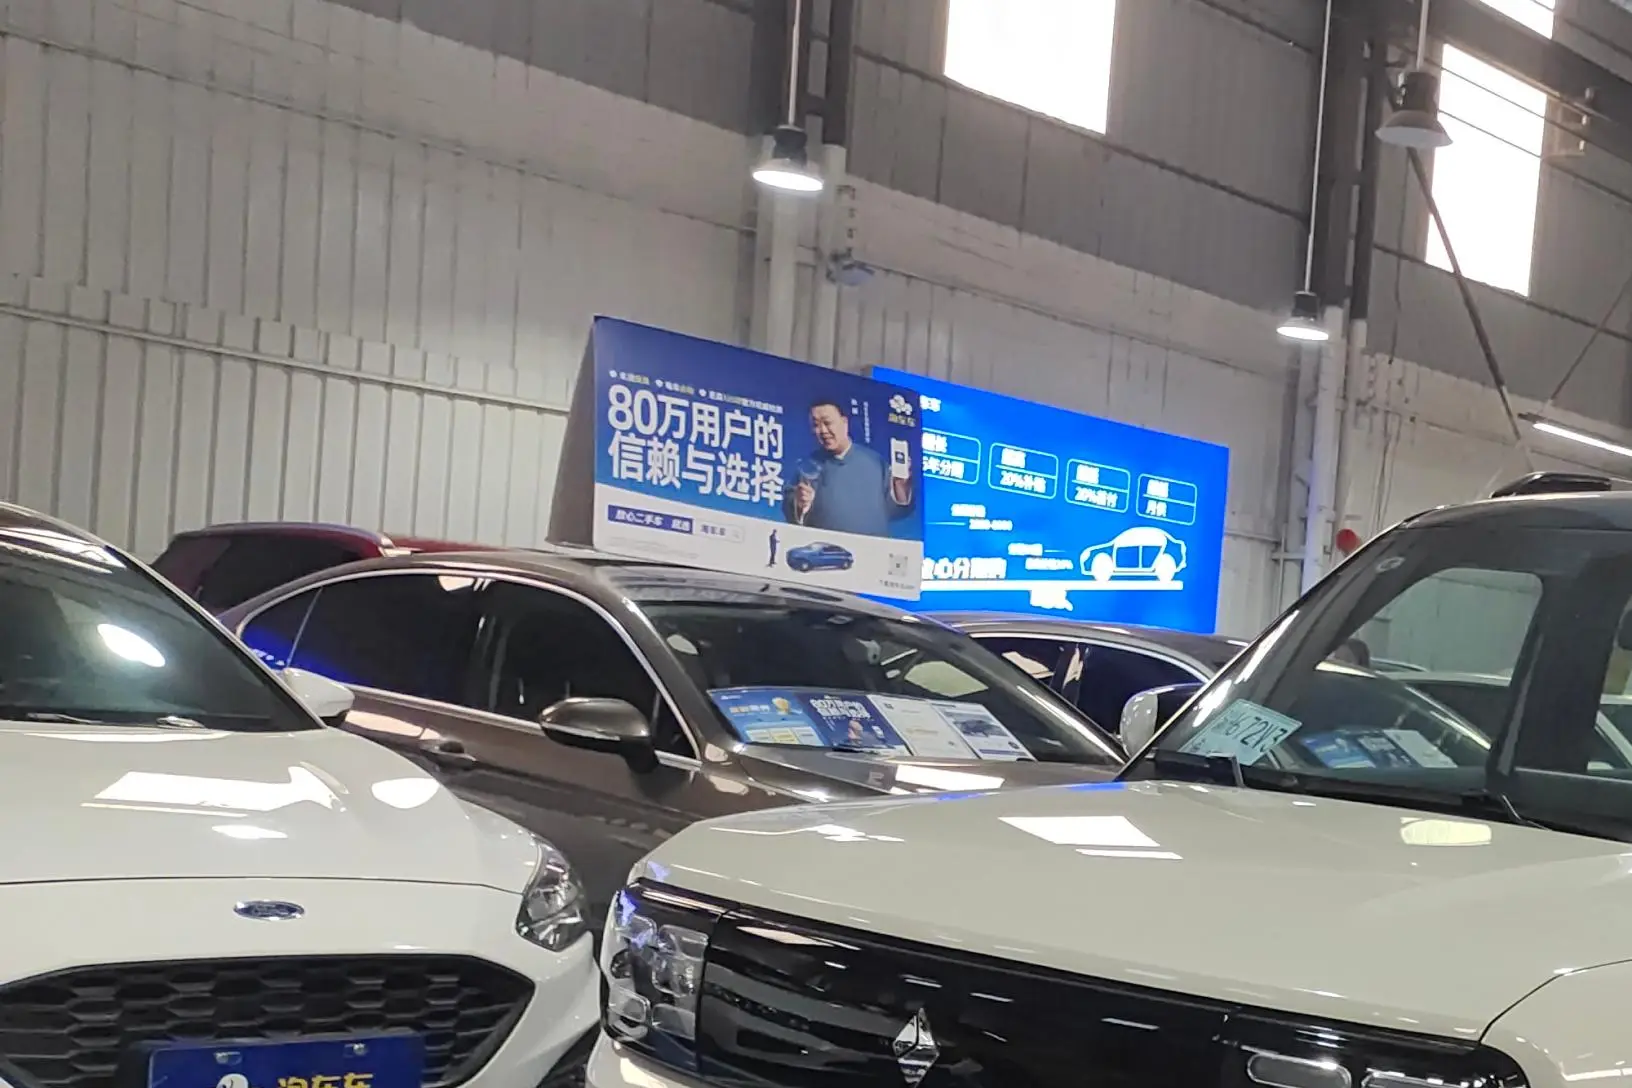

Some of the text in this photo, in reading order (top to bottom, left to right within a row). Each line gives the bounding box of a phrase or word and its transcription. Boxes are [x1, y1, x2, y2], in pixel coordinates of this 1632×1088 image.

[607, 384, 783, 459] 80万用户的
[608, 431, 784, 507] 信赖与选择
